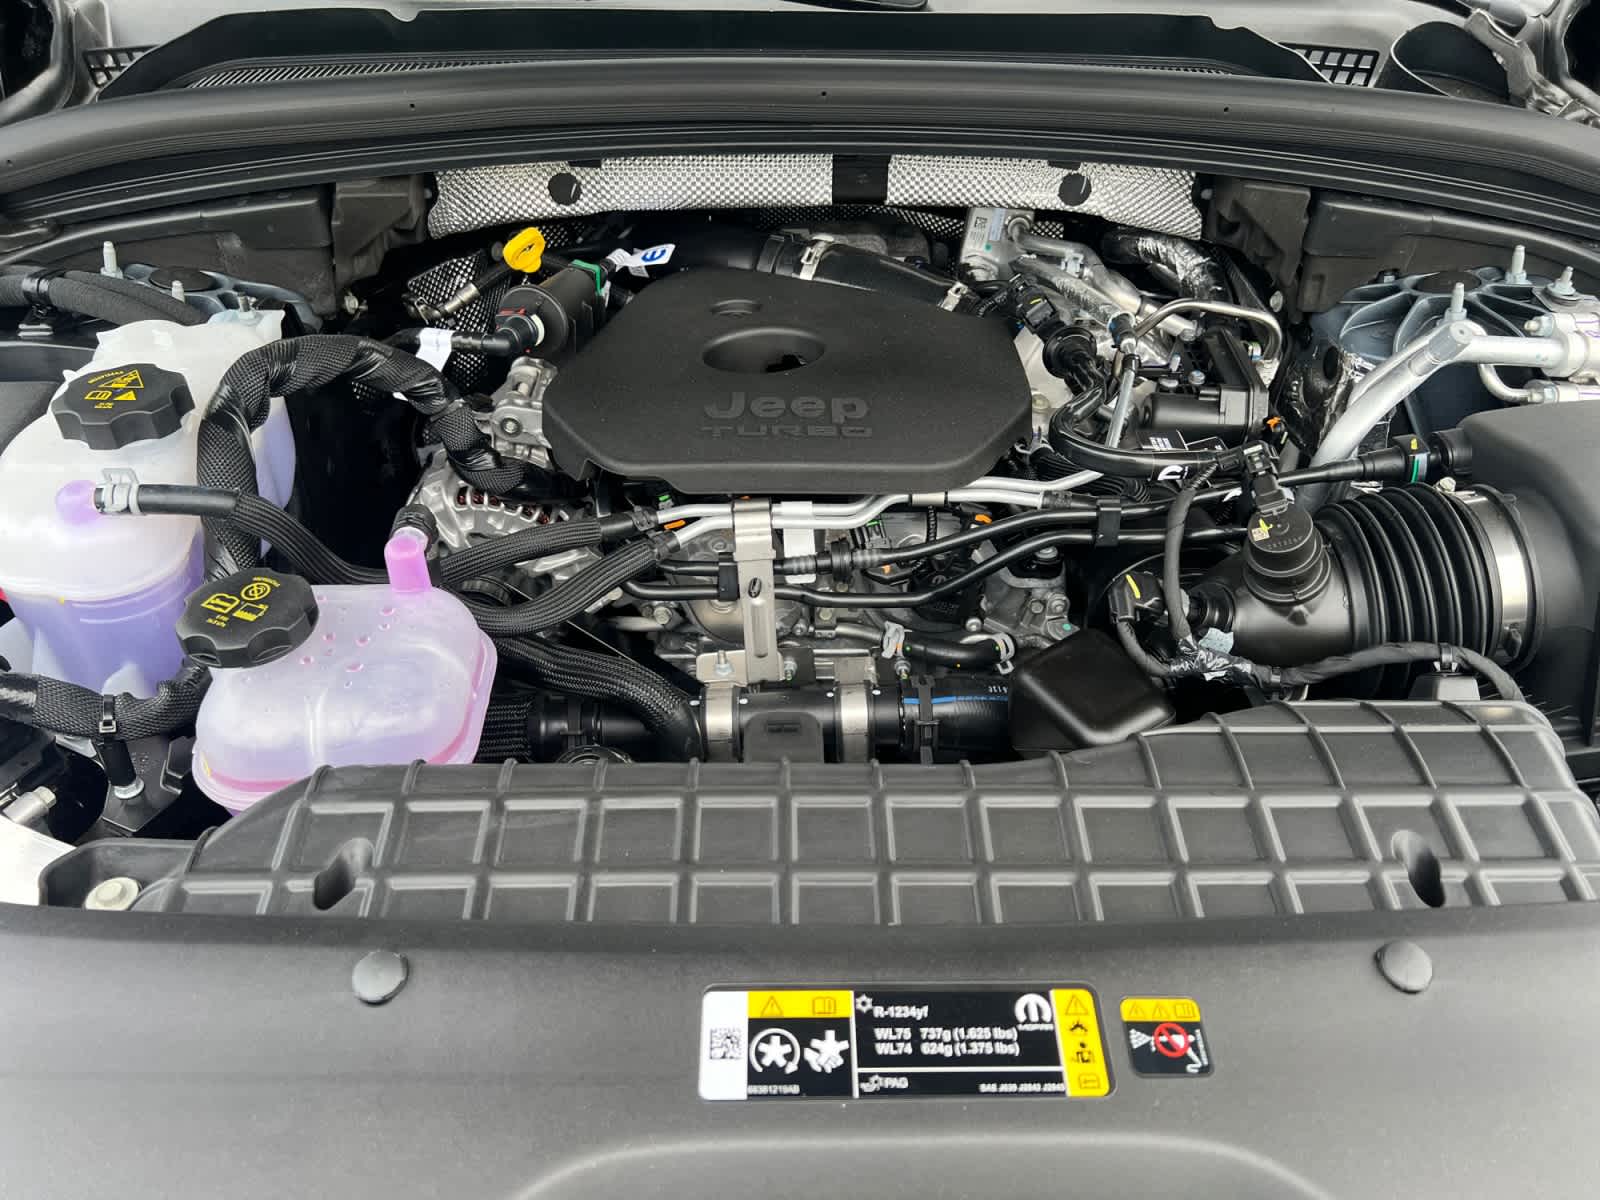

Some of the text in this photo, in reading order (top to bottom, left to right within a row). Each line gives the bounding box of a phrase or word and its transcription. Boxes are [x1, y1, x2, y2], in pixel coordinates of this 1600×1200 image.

[703, 391, 871, 425] Jeep
[701, 425, 873, 440] TURBO
[873, 1005, 929, 1020] R-1234yf
[874, 1027, 1018, 1042] WL75 737g (1.625 lbs)
[874, 1041, 1020, 1057] WL74 624g (1.375 lbs)
